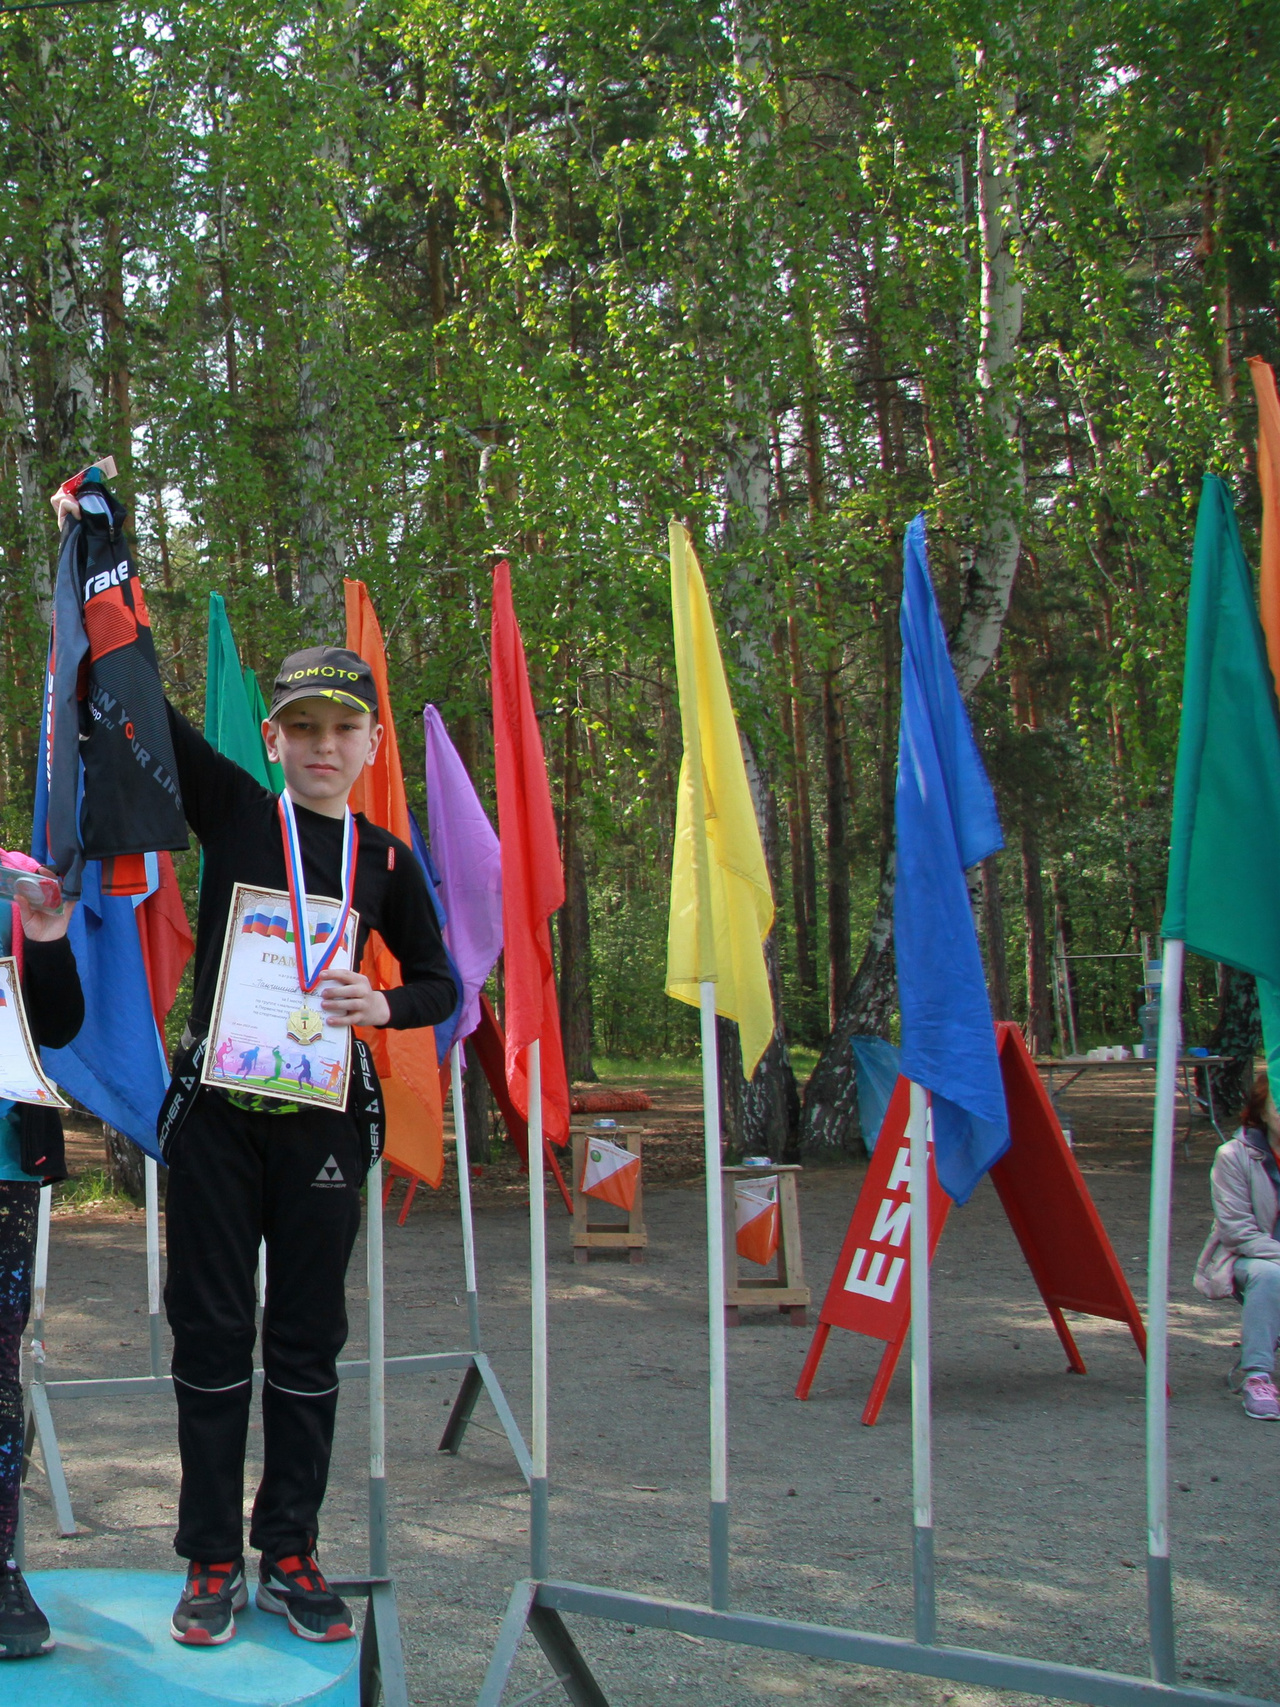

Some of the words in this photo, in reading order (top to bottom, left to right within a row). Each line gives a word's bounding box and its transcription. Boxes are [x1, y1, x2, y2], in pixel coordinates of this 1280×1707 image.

[118, 708, 151, 769] YOUR
[153, 765, 182, 811] LIFE
[302, 1021, 307, 1030] 1
